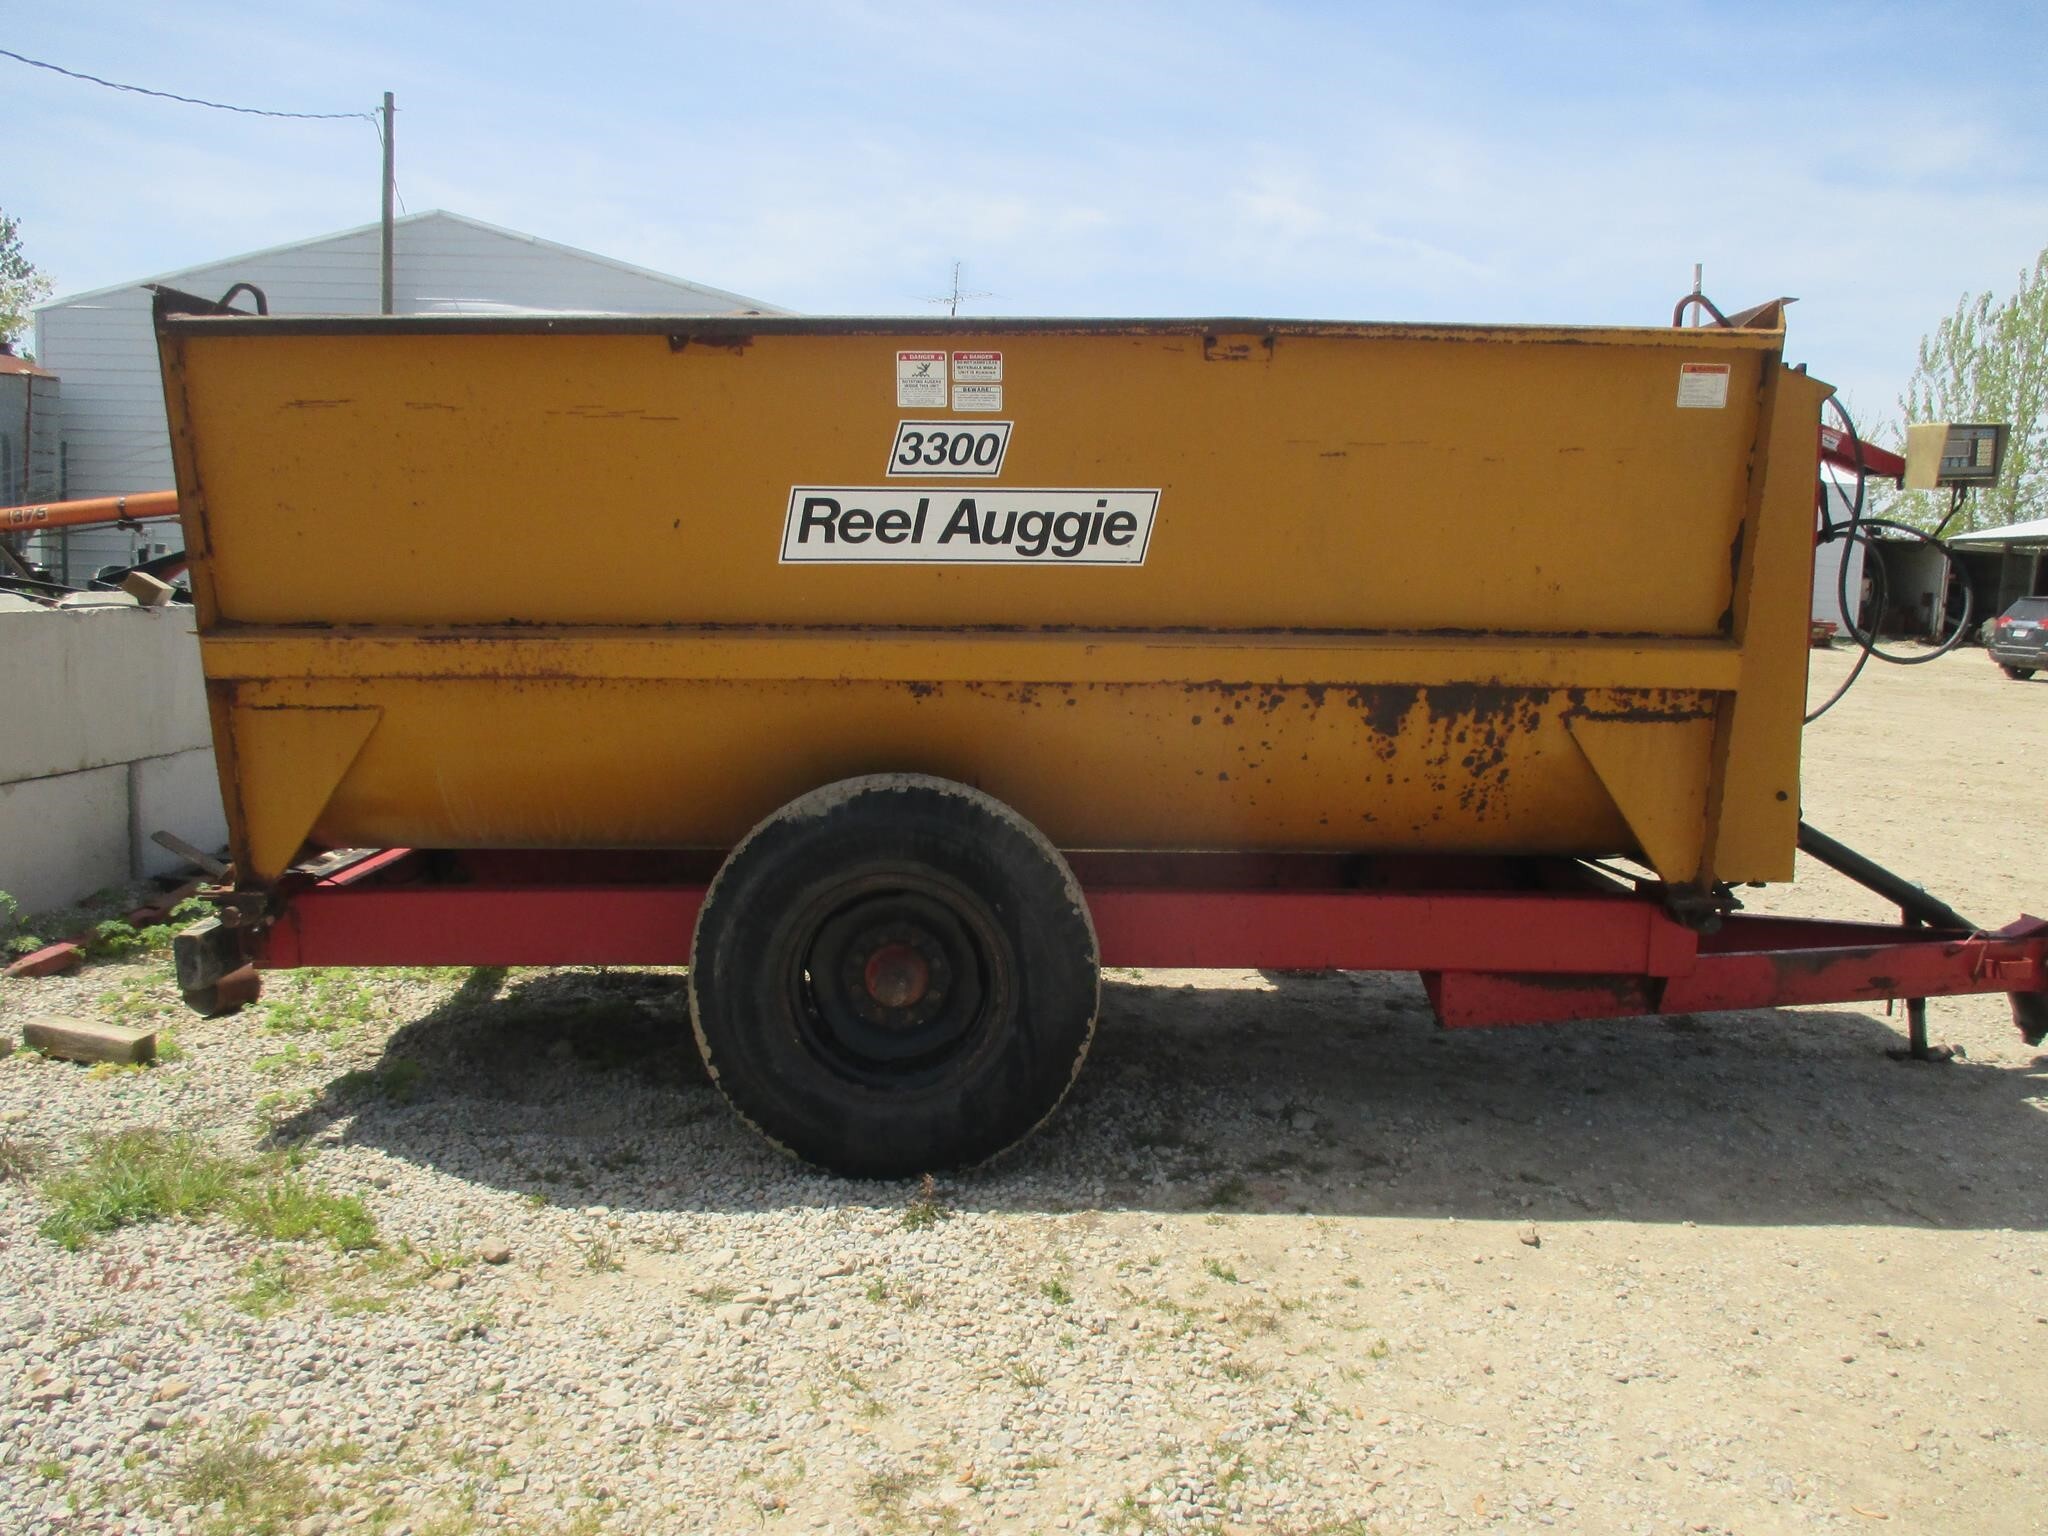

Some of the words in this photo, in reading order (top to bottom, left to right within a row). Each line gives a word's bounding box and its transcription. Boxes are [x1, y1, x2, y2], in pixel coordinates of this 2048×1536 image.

[898, 431, 1000, 466] 3300
[797, 497, 930, 544] Reel
[937, 497, 1138, 558] Auggie
